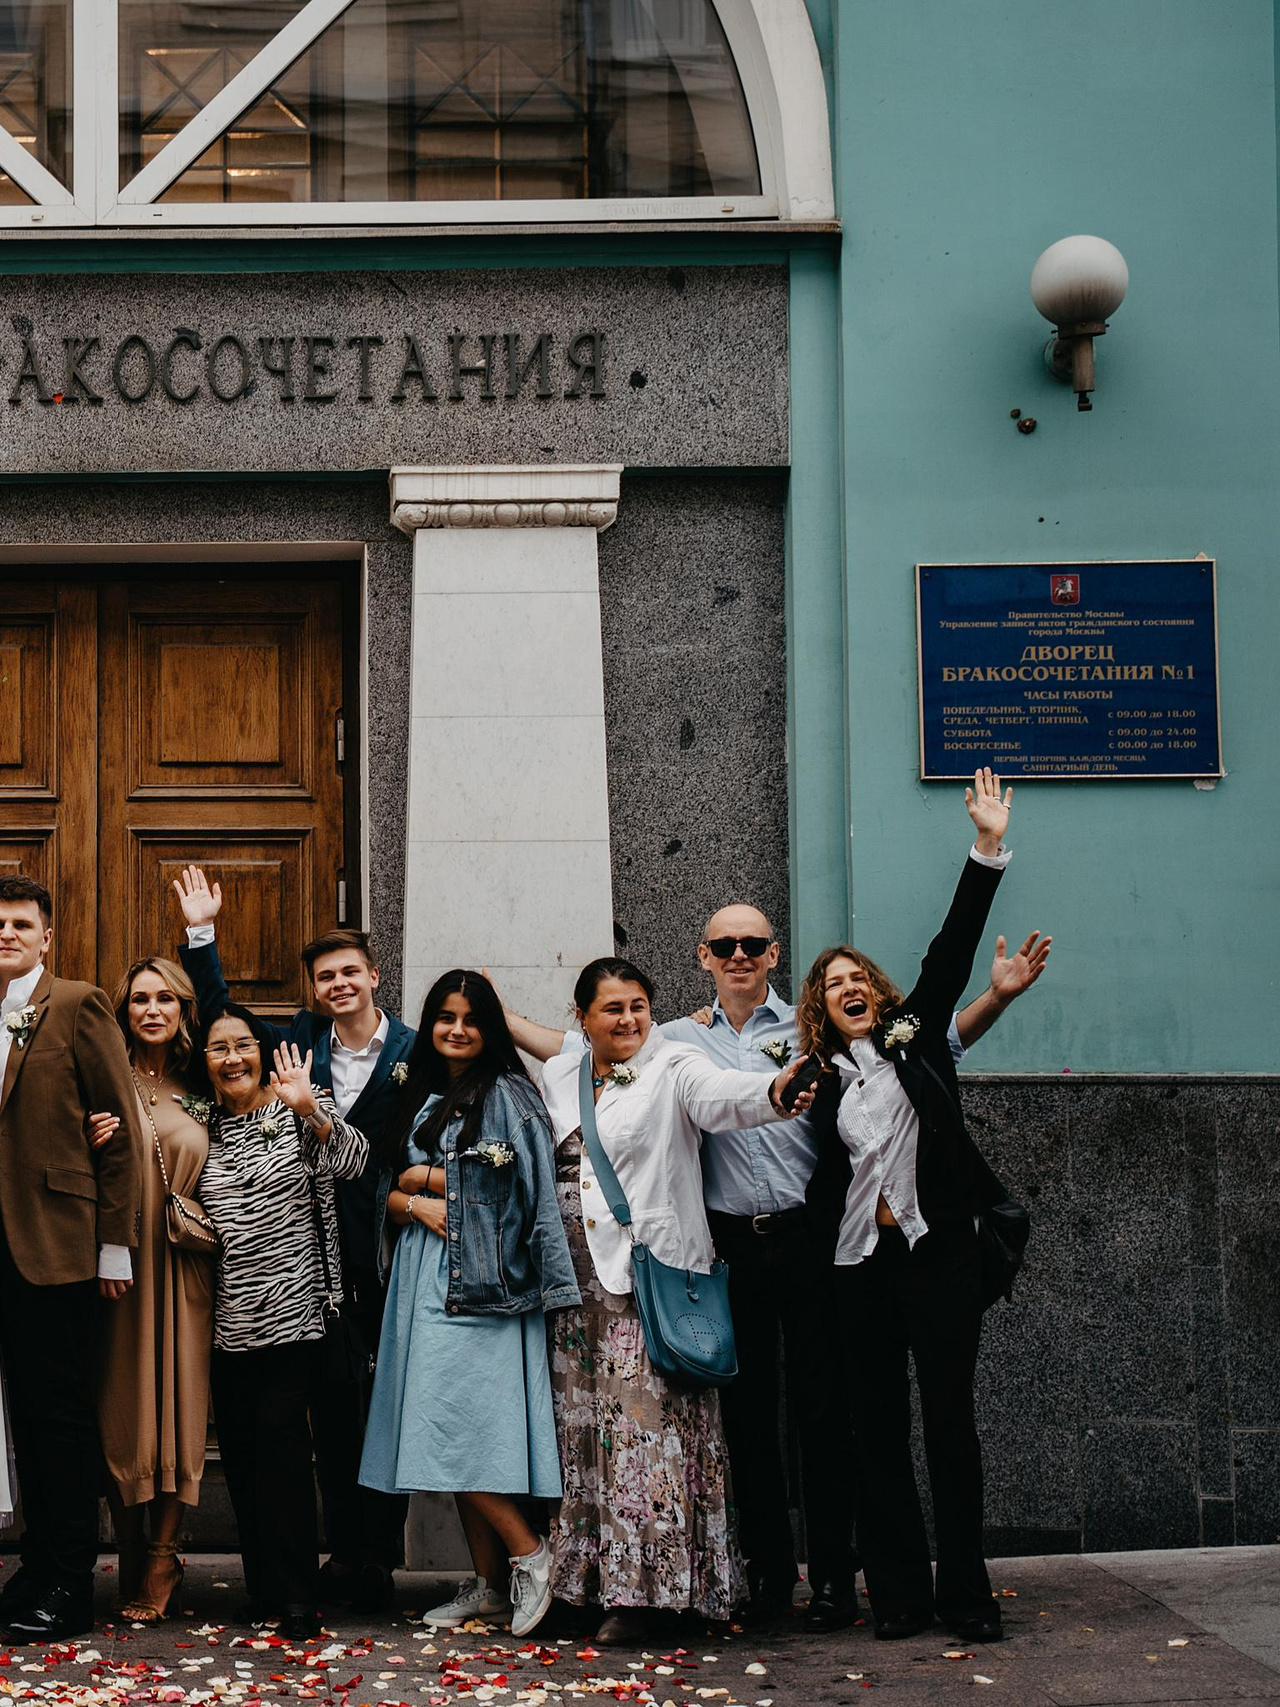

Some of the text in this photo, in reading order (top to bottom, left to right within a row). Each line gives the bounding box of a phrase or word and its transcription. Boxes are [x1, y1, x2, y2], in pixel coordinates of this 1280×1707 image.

[1008, 610, 1124, 619] Правительство Москвы
[939, 620, 998, 629] Управление
[1069, 620, 1140, 628] гражданского
[1028, 629, 1063, 637] города
[1020, 645, 1115, 664] ДВОРЕЦ
[942, 665, 1154, 681] БРАКОСОЧЕТАНИЯ
[1023, 690, 1113, 700] ЧАСЫ РАБОТЫ
[1116, 710, 1146, 718] 09.00
[1166, 709, 1196, 718] 18.00
[1038, 716, 1089, 724] ПЯТНИЦА
[943, 729, 992, 737] СУББОТА
[1117, 728, 1147, 736] 09.00
[1166, 728, 1197, 736] 24.00
[943, 742, 1021, 750] ВОСКРЕСЕНЬЕ
[1117, 741, 1148, 749] 00.00
[1167, 741, 1197, 749] 18.00
[1022, 763, 1118, 771] САНИТАРНЫЙ ДЕНЬ
